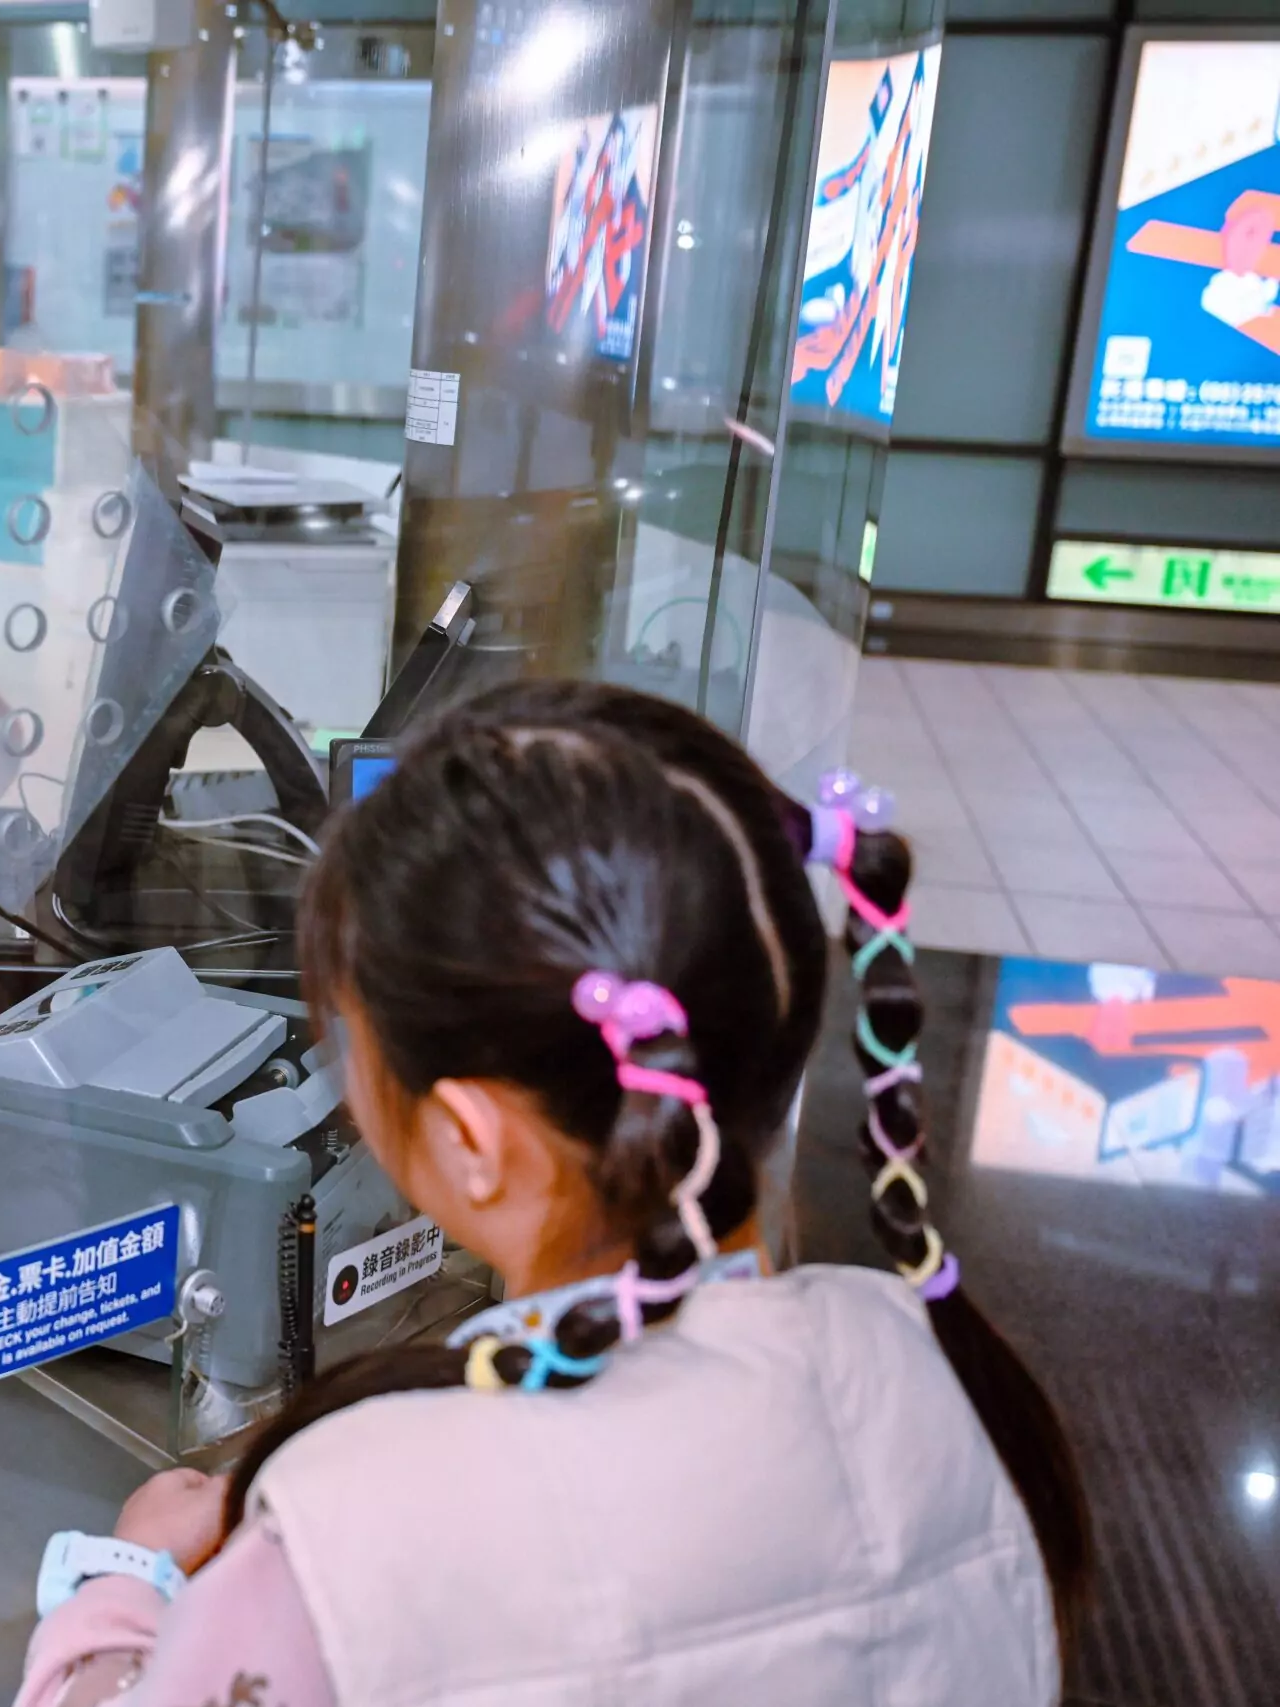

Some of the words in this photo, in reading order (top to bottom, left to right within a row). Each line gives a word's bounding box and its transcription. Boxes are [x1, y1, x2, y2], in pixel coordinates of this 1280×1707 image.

[360, 1270, 398, 1296] Recording
[399, 1266, 406, 1277] in
[407, 1251, 438, 1274] Progress
[361, 1223, 440, 1281] 錄音錄影中
[2, 1351, 14, 1370] is
[15, 1333, 67, 1361] available
[68, 1326, 84, 1341] on
[85, 1311, 130, 1336] request.
[25, 1321, 52, 1342] your
[53, 1307, 98, 1331] change,
[100, 1292, 139, 1315] tickets,
[141, 1281, 162, 1301] and
